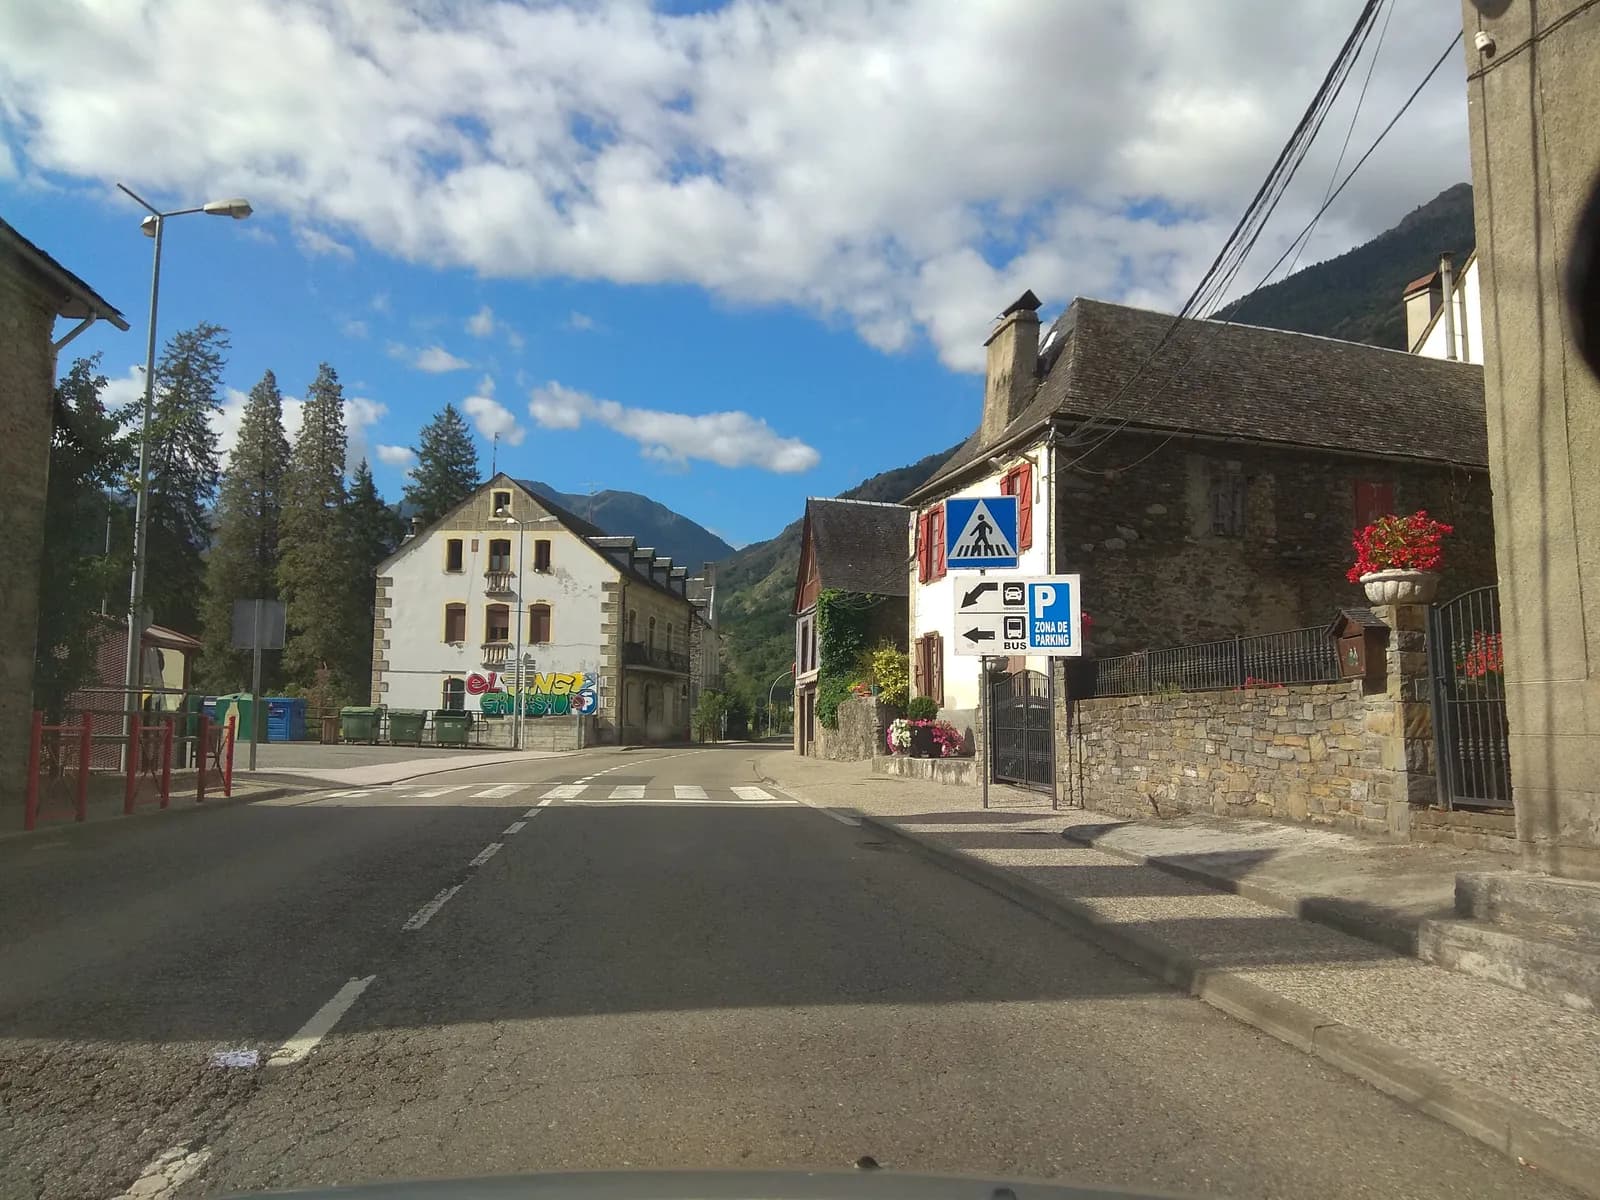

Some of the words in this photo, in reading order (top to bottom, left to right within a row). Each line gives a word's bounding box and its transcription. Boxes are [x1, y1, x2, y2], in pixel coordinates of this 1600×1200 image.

[1034, 585, 1057, 619] P
[1035, 621, 1056, 633] ZONA
[1057, 621, 1068, 633] DE
[1004, 642, 1027, 650] BUS
[1035, 634, 1070, 646] PARKING
